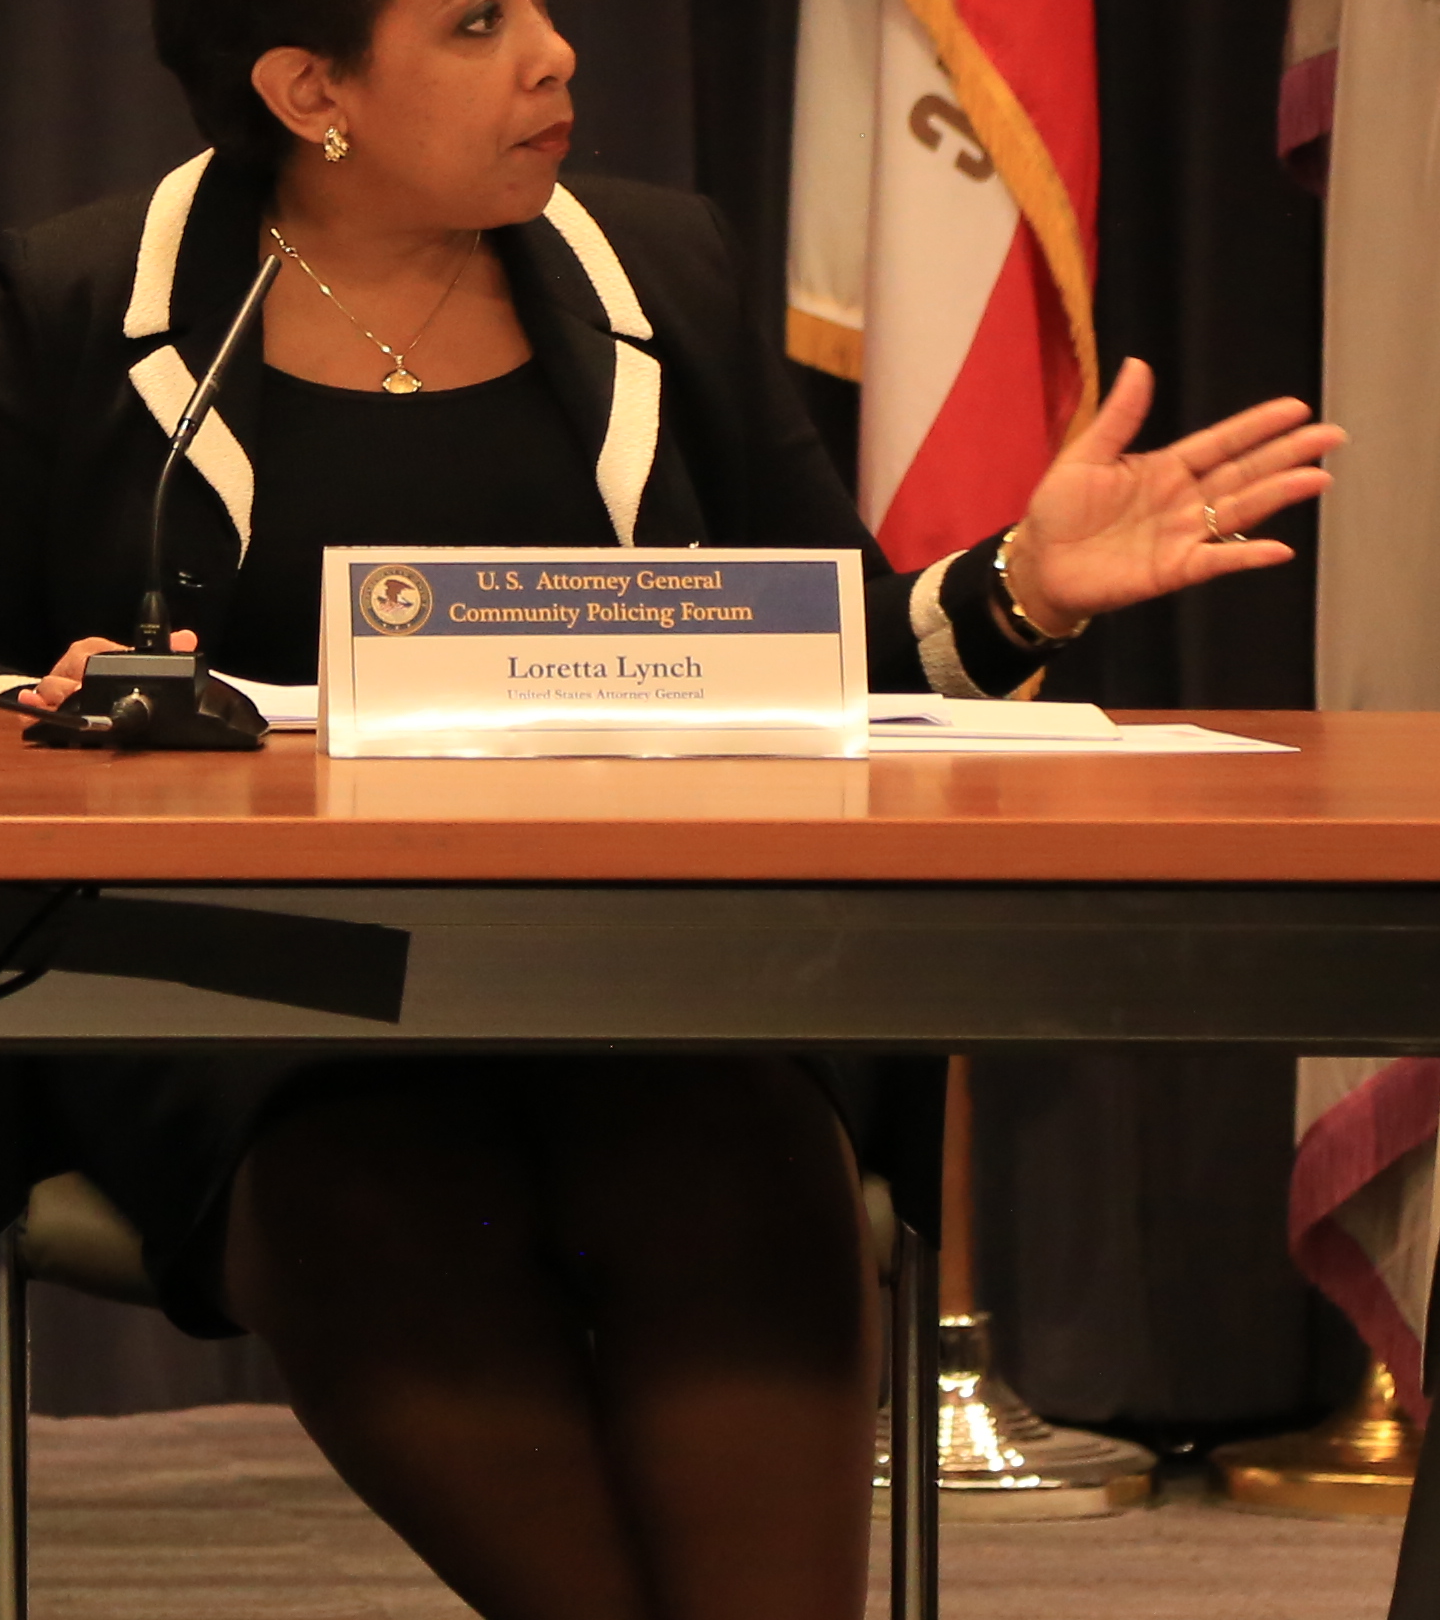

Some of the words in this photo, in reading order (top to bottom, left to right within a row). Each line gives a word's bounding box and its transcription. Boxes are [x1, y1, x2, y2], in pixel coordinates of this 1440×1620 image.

[536, 572, 632, 596] Attorney
[636, 571, 722, 590] General
[449, 603, 581, 628] Community
[587, 603, 675, 627] Policing
[680, 602, 753, 621] Forum
[507, 657, 607, 679] Loretta
[616, 656, 702, 685] Lynch
[507, 689, 550, 699] United
[554, 690, 592, 700] States
[596, 689, 651, 701] Attorney
[655, 688, 704, 699] General
